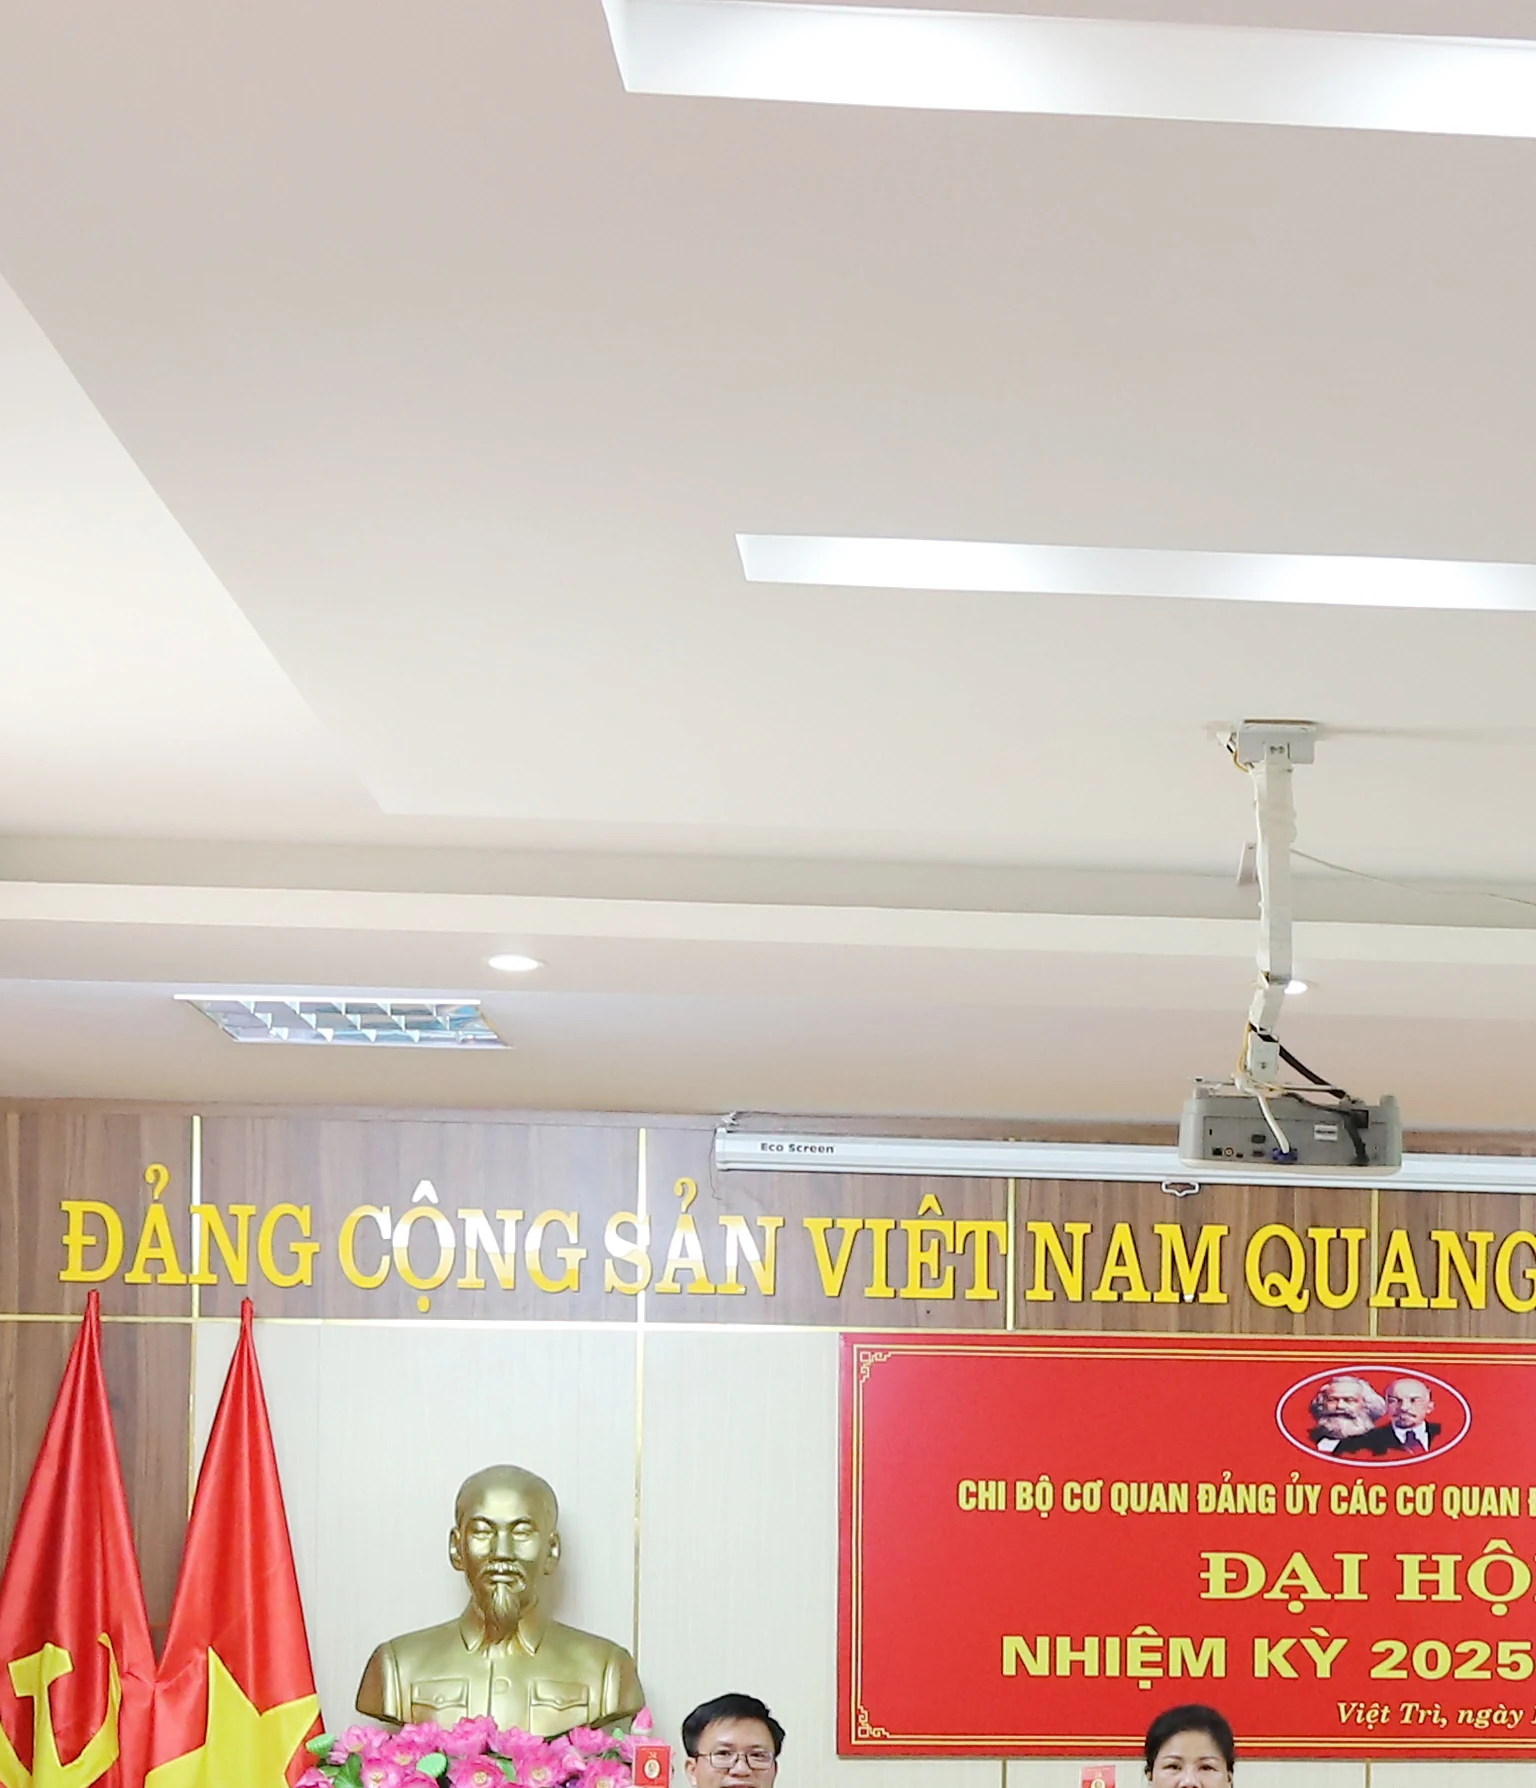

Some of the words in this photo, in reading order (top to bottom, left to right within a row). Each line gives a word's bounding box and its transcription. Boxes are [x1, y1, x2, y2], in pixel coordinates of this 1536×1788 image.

[760, 1142, 784, 1152] Eco
[788, 1143, 835, 1154] Screen
[58, 1162, 321, 1287] ĐẢNG
[337, 1179, 587, 1313] CỘNG
[603, 1177, 785, 1296] SẢN
[1024, 1221, 1230, 1304] NAM
[958, 1479, 1006, 1511] CHI
[1015, 1474, 1054, 1518] BỘ
[1063, 1479, 1105, 1512] CƠ
[1110, 1482, 1189, 1516] QUAN
[1196, 1470, 1276, 1514] ĐẢNG
[1285, 1471, 1322, 1515] ỦY
[1330, 1478, 1387, 1516] CÁC
[1395, 1483, 1437, 1517] CƠ
[1441, 1485, 1520, 1520] QUAN
[1199, 1551, 1368, 1614] ĐẠI
[1002, 1625, 1226, 1690] NHIỆM
[1254, 1627, 1348, 1678] KỲ
[1370, 1640, 1534, 1681] 2025
[1337, 1702, 1391, 1730] Việt
[1399, 1702, 1448, 1728] Trì,
[1457, 1703, 1524, 1729] ngày
